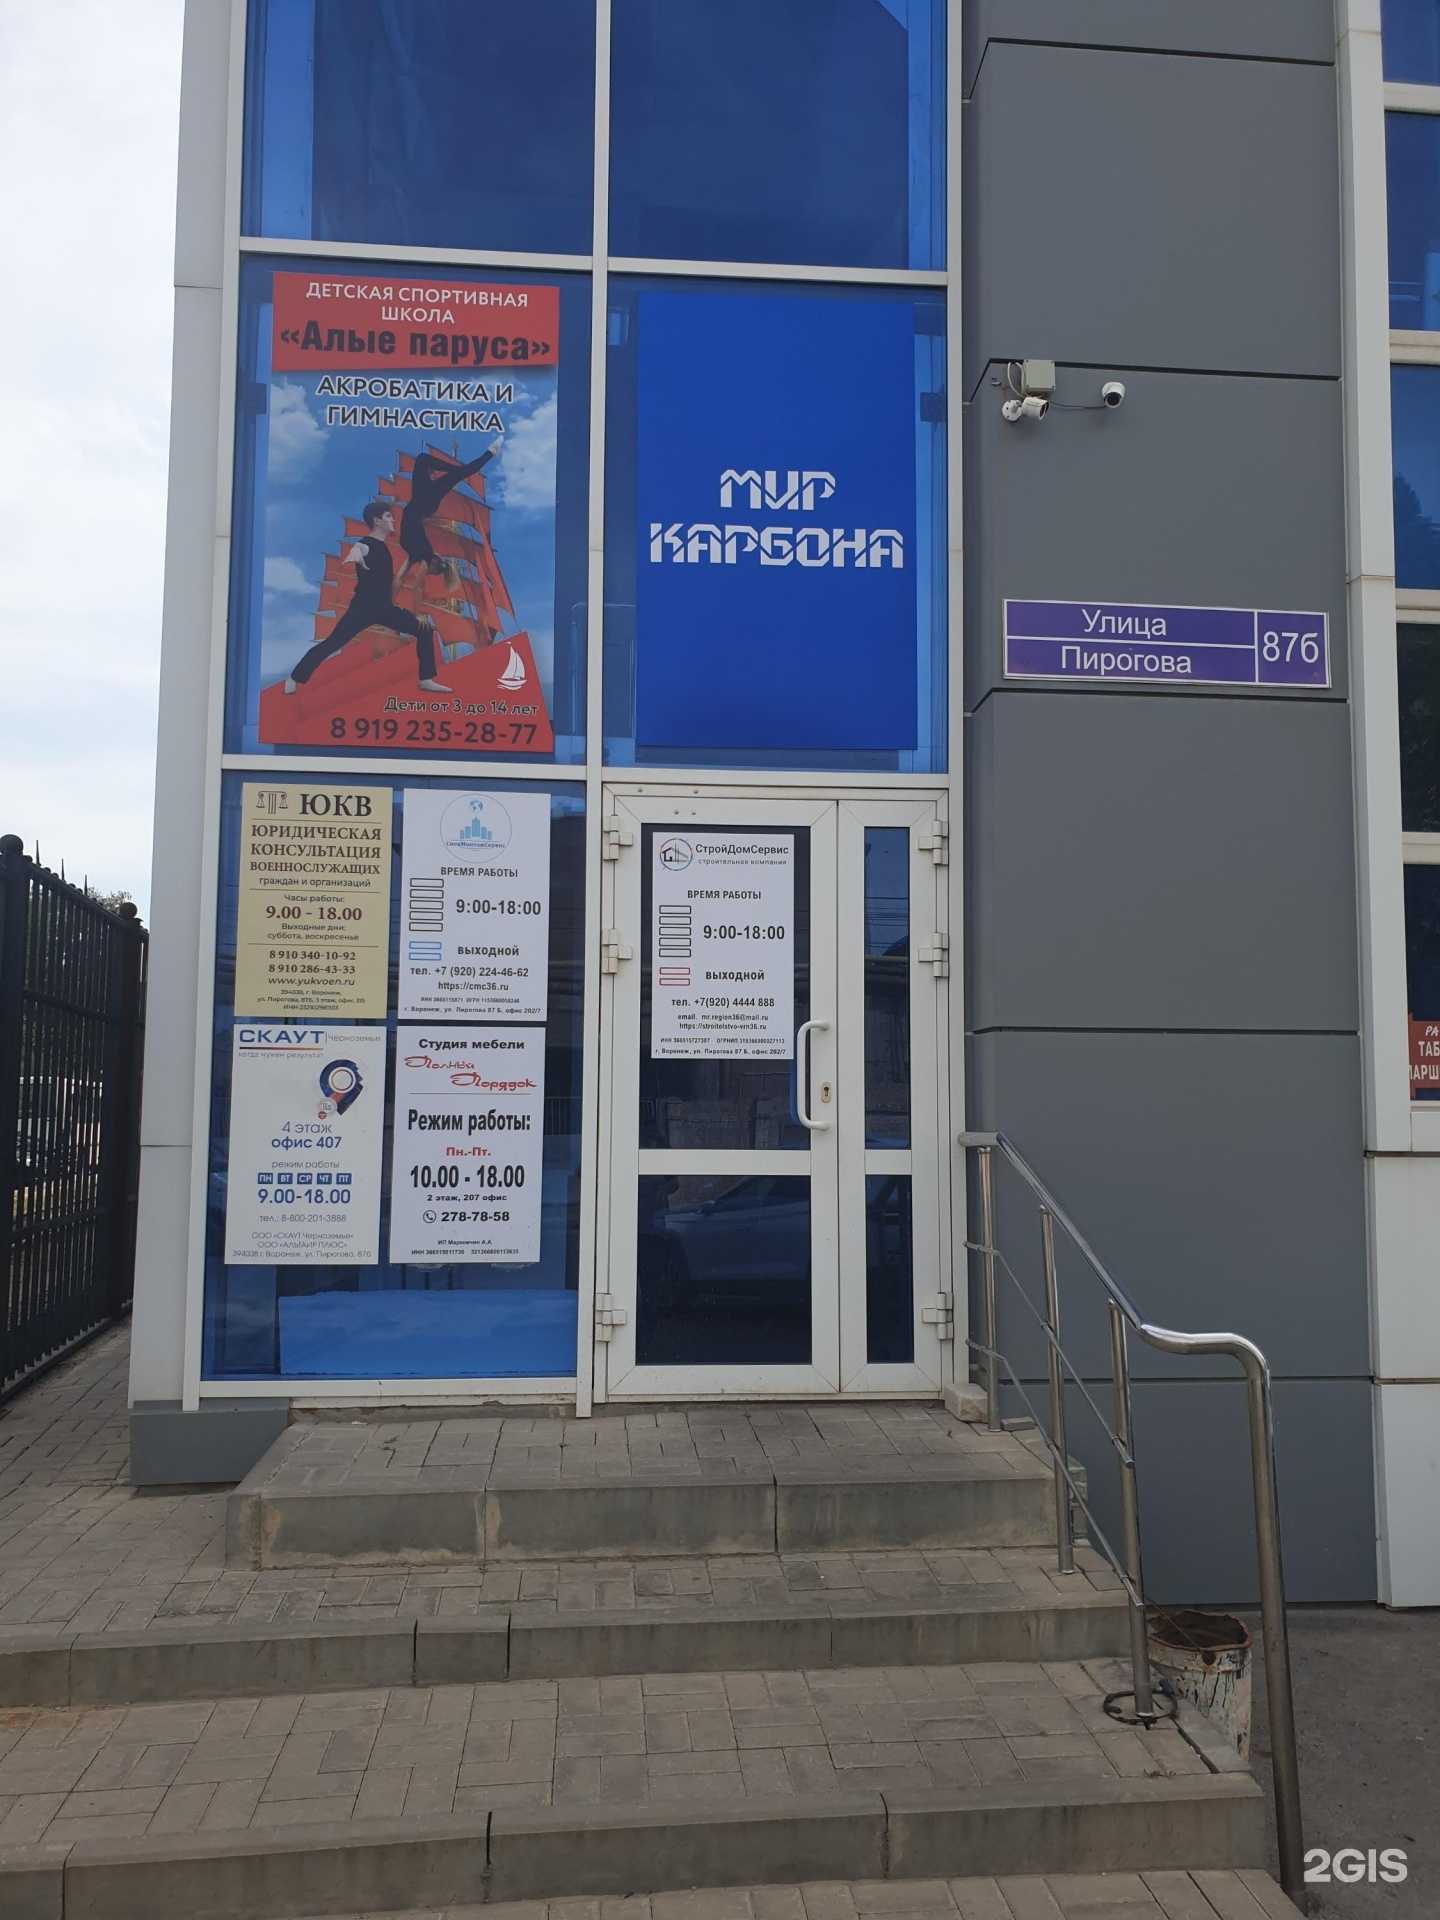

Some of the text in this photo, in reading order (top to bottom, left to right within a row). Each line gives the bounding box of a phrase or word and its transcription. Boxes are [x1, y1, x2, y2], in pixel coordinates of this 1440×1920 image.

[306, 282, 528, 307] ДЕТСКАЯ СПОРТИВНАЯ
[381, 306, 455, 324] ШКОЛА
[280, 320, 550, 366] «Алые паруса»
[317, 376, 513, 403] АКРОБАТИКА И
[327, 405, 505, 432] ГИМНАСТИКА
[720, 469, 836, 510] МИР
[650, 523, 903, 568] КАРБОНА
[1082, 609, 1167, 639] Улица
[1262, 632, 1319, 663] 87б
[1061, 645, 1192, 675] Пирогова
[384, 697, 538, 715] Дети от 3 до 14 лет
[331, 718, 537, 744] 8 919 235-28-77
[299, 793, 372, 816] ЮКВ
[251, 825, 381, 840] ЮРИДИЧЕСКАЯ
[250, 844, 381, 859] КОНСУЛЬТАЦИЯ
[696, 844, 788, 855] СтройДомСервис
[250, 862, 380, 874] ВОЕННОСЛУЖАЩИХ
[441, 867, 518, 877] ВРЕМЯ РАБОТЫ
[259, 878, 299, 886] граждан
[310, 879, 371, 888] организаций
[284, 894, 307, 902] Часы
[688, 890, 761, 899] ВРЕМЯ РАБОТЫ
[266, 906, 301, 919] 9.00
[318, 907, 362, 920] 18.00
[456, 899, 541, 915] 9:00-18:00
[703, 925, 785, 939] 9:00-18:00
[279, 951, 297, 959] 910
[300, 952, 356, 961] 340-10-92
[269, 964, 355, 974] 8 910 286-43-33
[435, 967, 446, 975] +7
[450, 967, 476, 977] (920)
[479, 967, 528, 977] 224-46-62
[694, 998, 729, 1008] +7(920)
[733, 998, 755, 1006] 4444
[758, 999, 775, 1007] 888
[240, 1030, 324, 1043] СКАУТ
[419, 1039, 524, 1051] Студия мебели
[282, 1121, 332, 1133] 4 этаж
[408, 1109, 531, 1136] Режим работы:
[272, 1136, 342, 1150] офис 407
[446, 1147, 491, 1156] Пн.-Пт.
[260, 1174, 272, 1182] ПН
[411, 1165, 459, 1188] 10.00
[477, 1165, 524, 1188] 18.00
[441, 1211, 510, 1222] 278-78-58
